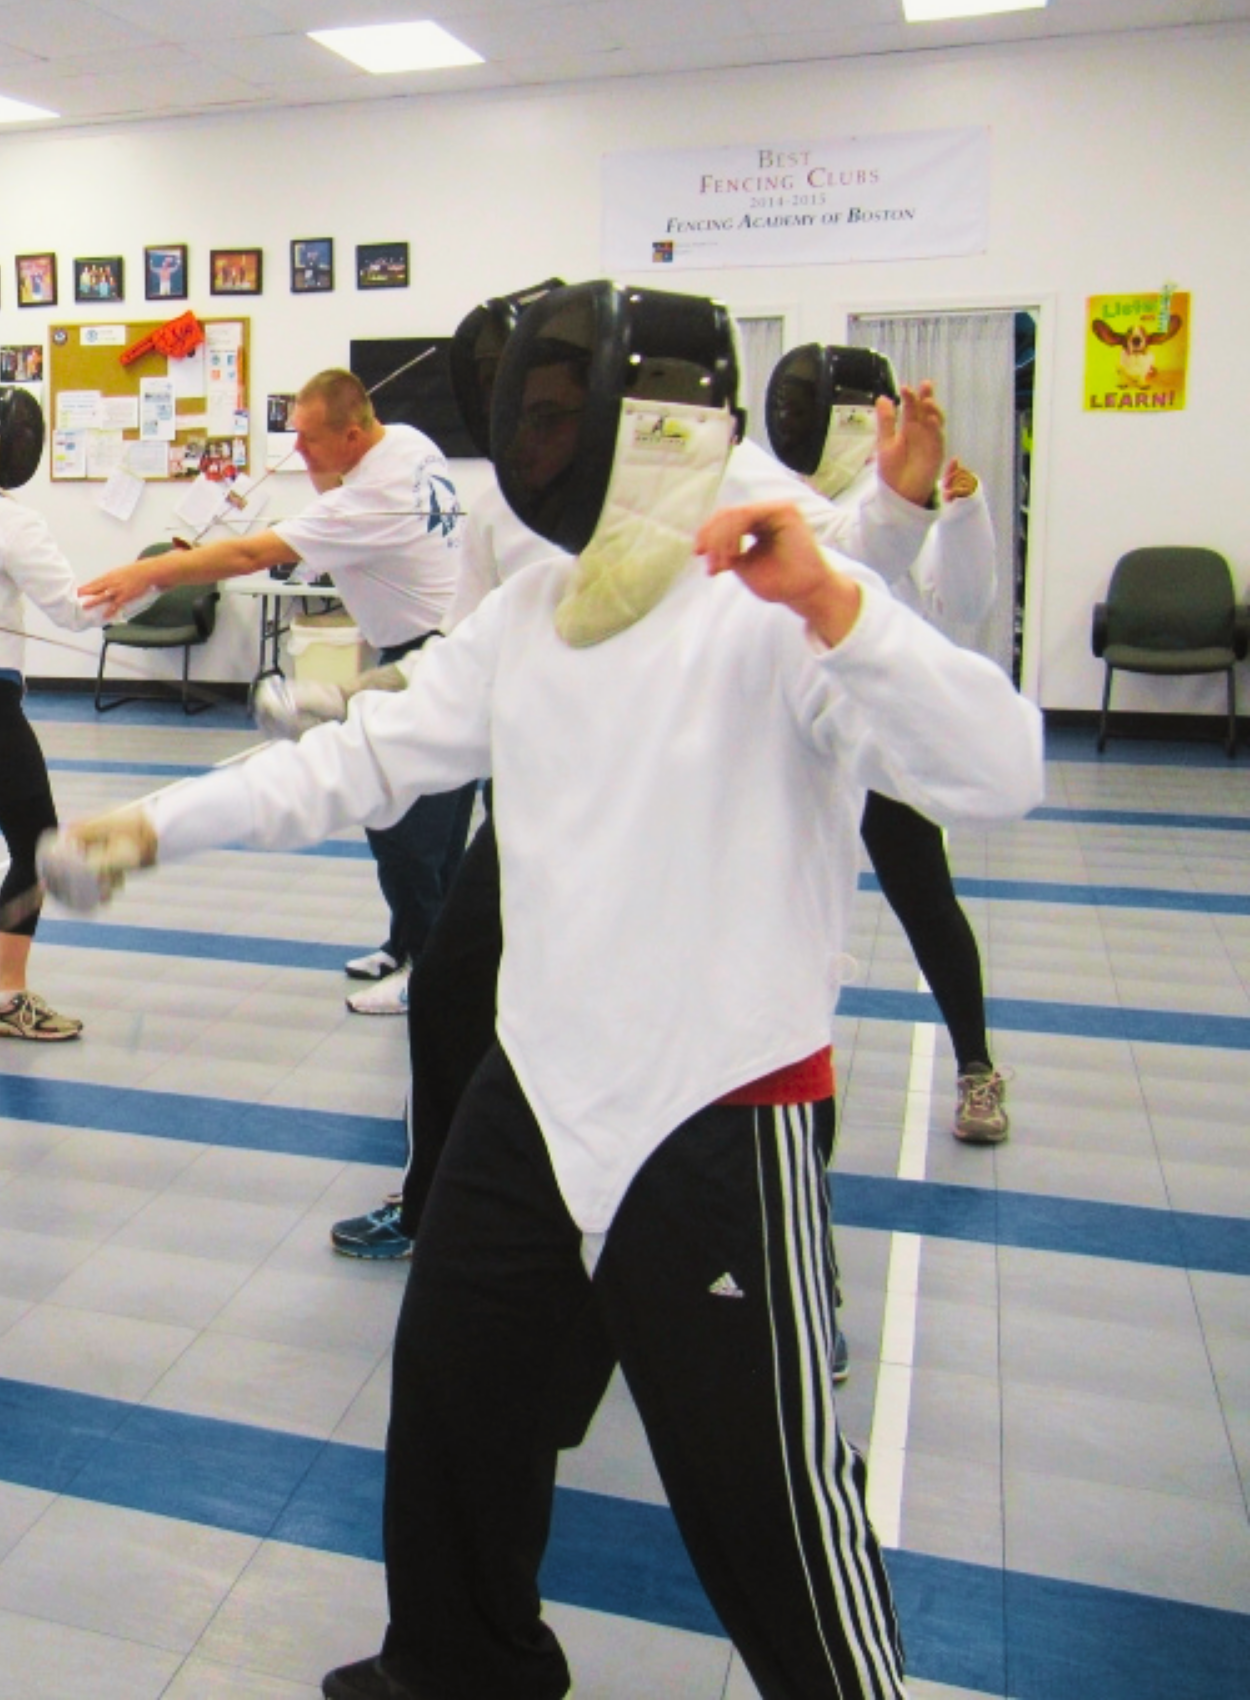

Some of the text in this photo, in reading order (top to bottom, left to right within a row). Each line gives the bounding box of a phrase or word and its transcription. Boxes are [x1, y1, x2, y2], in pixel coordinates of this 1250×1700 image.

[757, 149, 812, 169] BEST
[699, 166, 880, 194] FENCING CLUBS
[749, 192, 826, 208] 2014-2015
[665, 206, 916, 233] FENCING ACADEMY OF BOSTON
[1090, 390, 1176, 407] LEARN!
